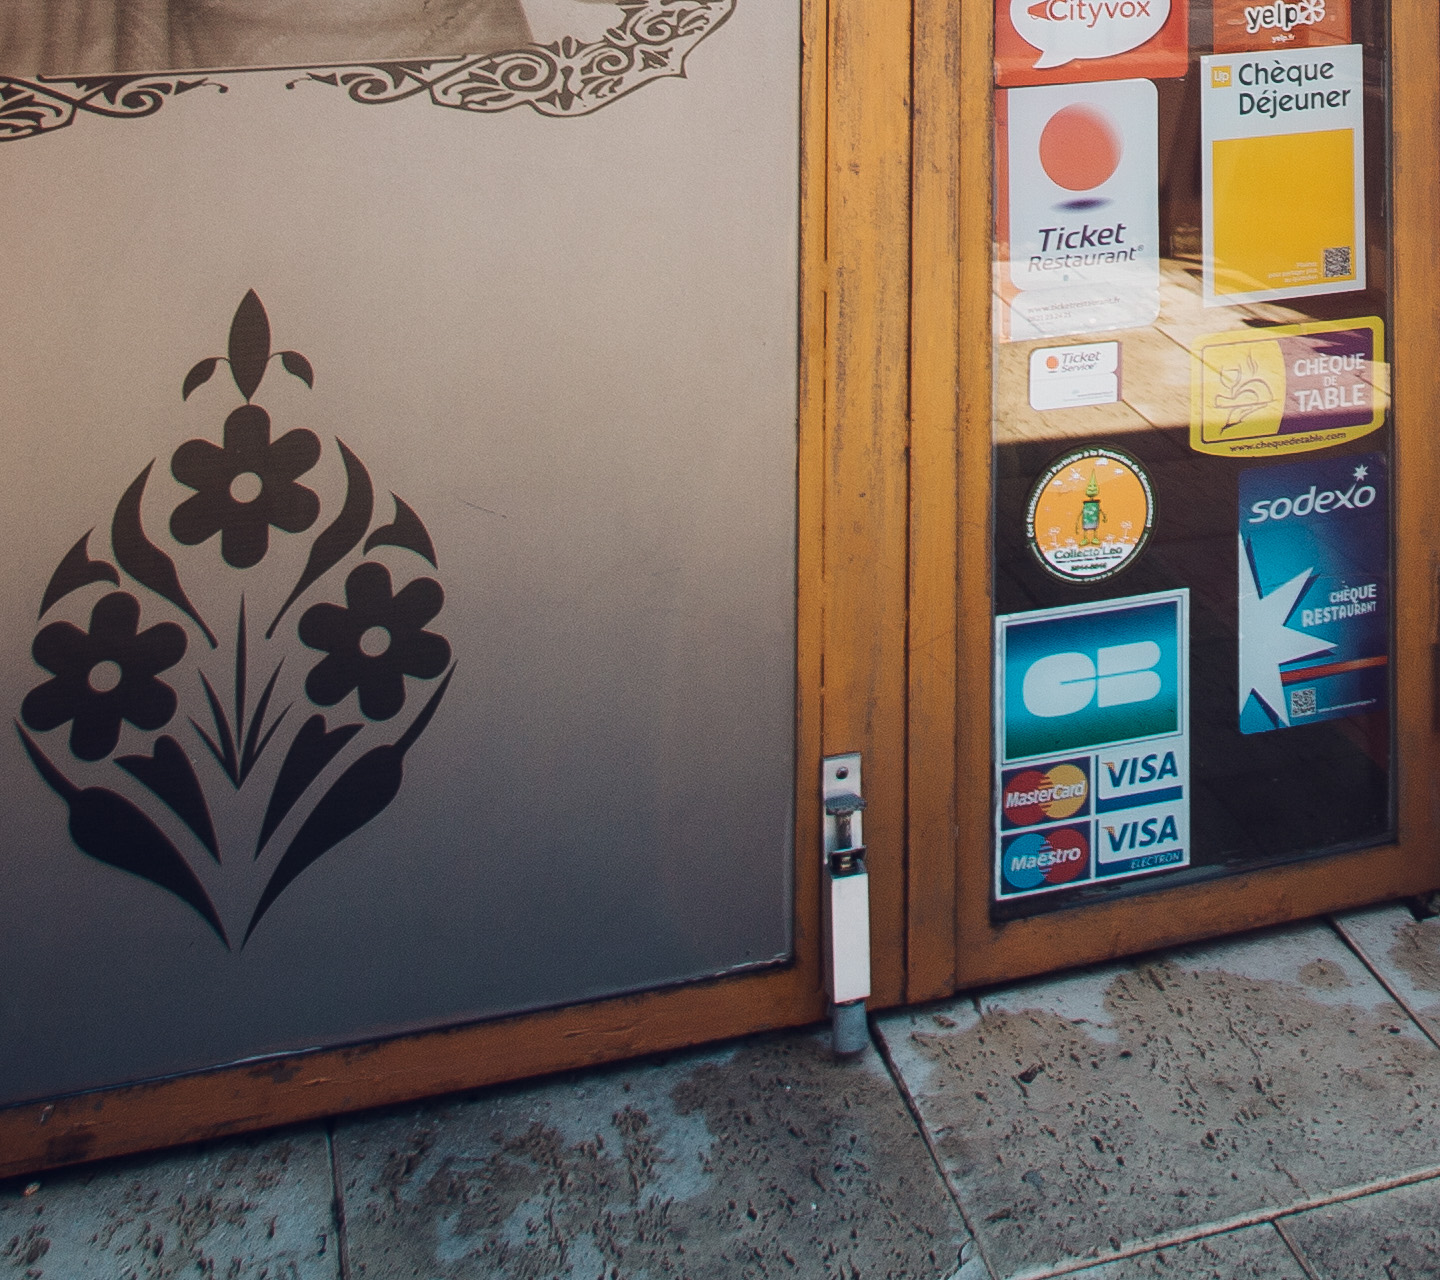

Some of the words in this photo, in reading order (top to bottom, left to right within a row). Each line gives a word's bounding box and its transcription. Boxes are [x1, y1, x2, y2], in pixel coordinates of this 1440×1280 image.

[1246, 1, 1299, 32] yelp
[1238, 60, 1334, 87] Chèque
[1239, 89, 1351, 118] Déjeuner
[1039, 223, 1127, 252] Ticket
[1062, 351, 1102, 364] Ticket
[1293, 352, 1366, 377] CHÈQUE
[1323, 375, 1337, 387] DE
[1294, 384, 1366, 413] TABLE
[1229, 431, 1347, 453] www.chequedetable.com
[1248, 484, 1376, 524] sodexo
[1329, 582, 1377, 604] CHÈQUE
[1301, 601, 1377, 628] RESTAURANT
[1005, 780, 1086, 809] MasterCard
[1101, 751, 1178, 788] VISA
[1011, 847, 1082, 872] Maestro
[1101, 815, 1178, 852] VISA
[1130, 852, 1181, 870] ELECTRON
